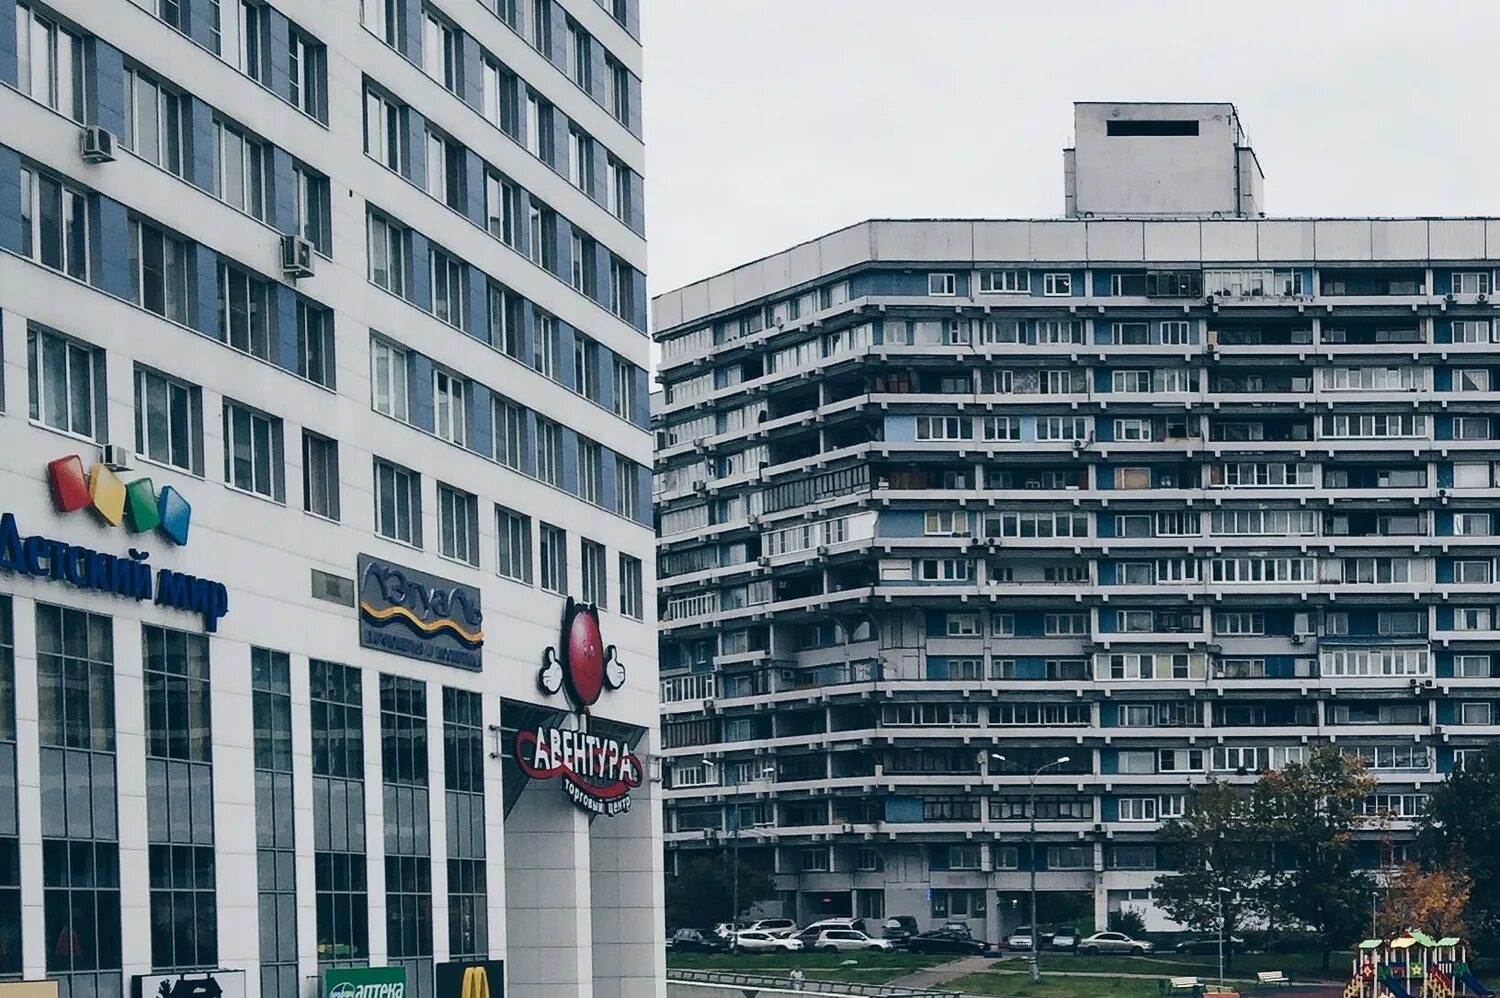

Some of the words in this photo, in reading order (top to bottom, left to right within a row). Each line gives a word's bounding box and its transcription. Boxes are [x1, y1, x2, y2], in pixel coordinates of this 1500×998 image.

[0, 513, 152, 601] Детский
[155, 569, 228, 632] мир
[534, 726, 632, 781] АВЕНТУРА
[564, 778, 603, 813] торговый
[608, 796, 631, 814] центр
